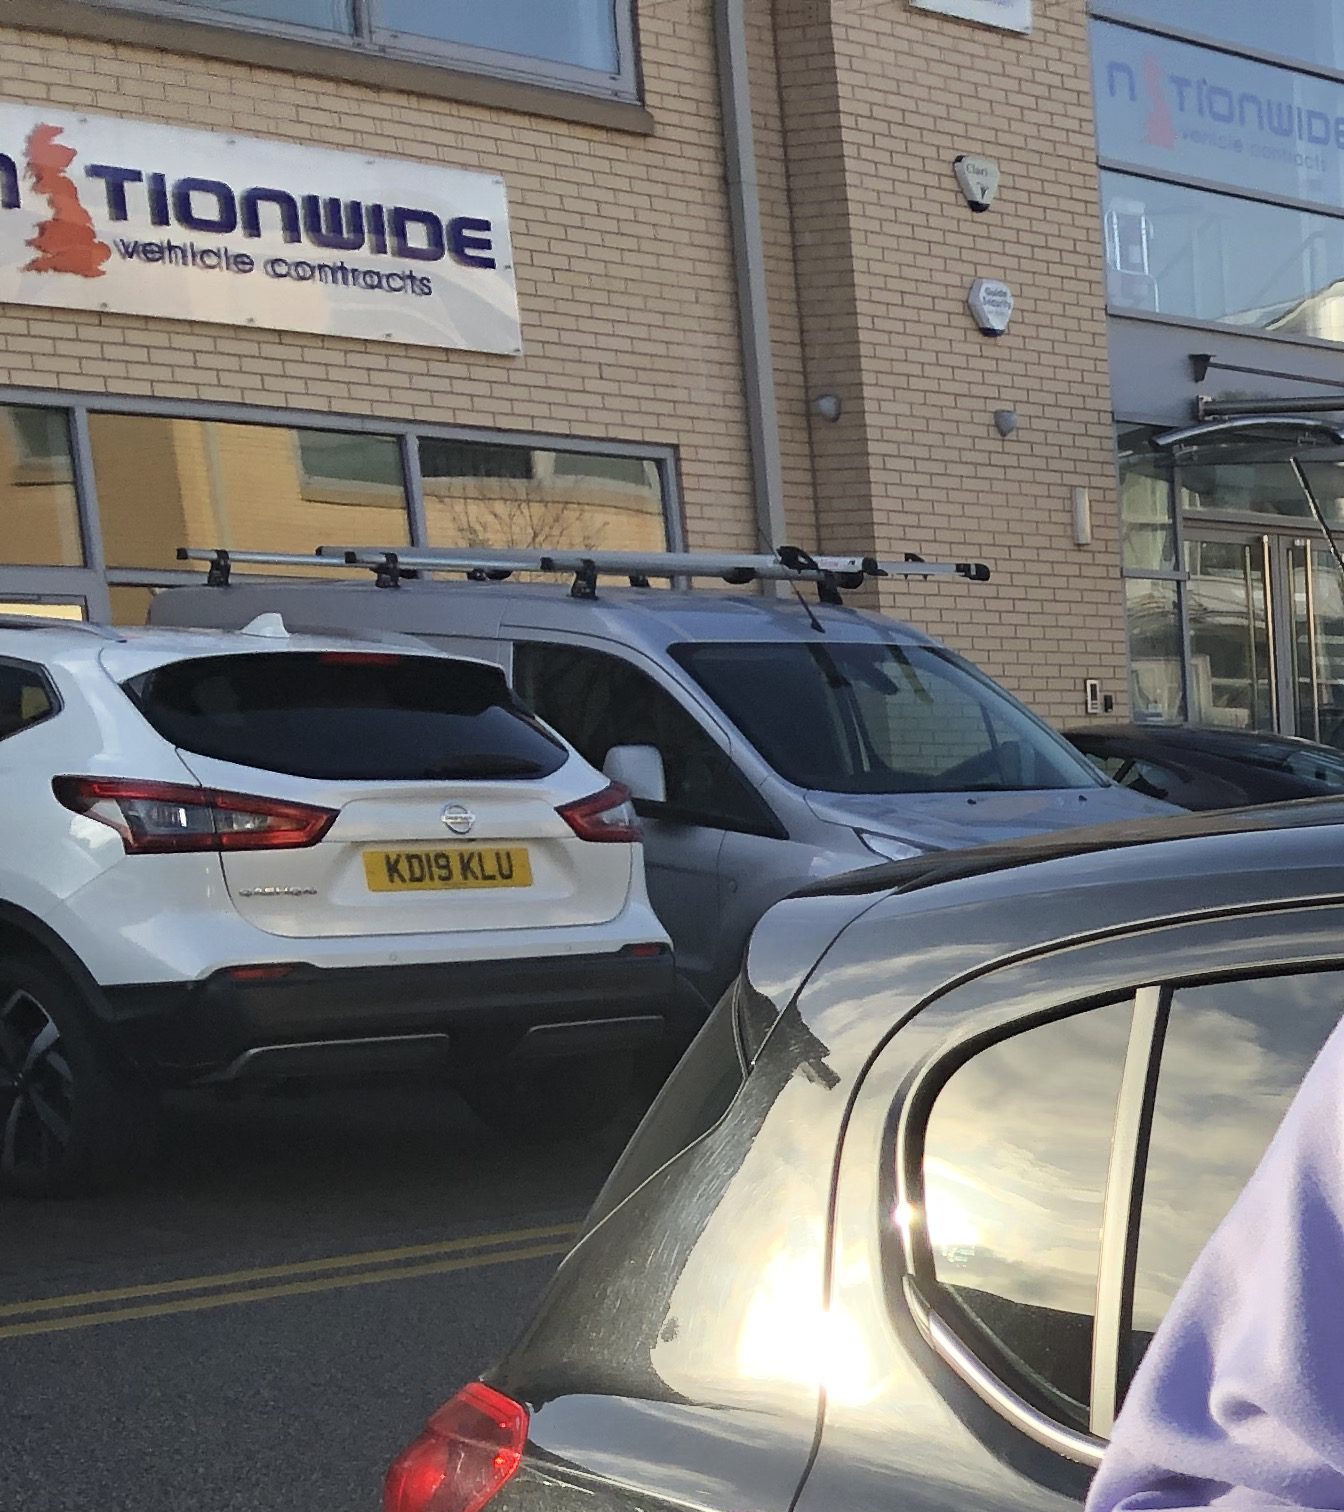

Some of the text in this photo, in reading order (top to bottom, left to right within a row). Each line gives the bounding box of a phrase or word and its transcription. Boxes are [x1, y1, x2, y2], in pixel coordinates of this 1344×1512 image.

[115, 238, 433, 297] vehicle contracts
[384, 850, 514, 884] KD19 KLU
